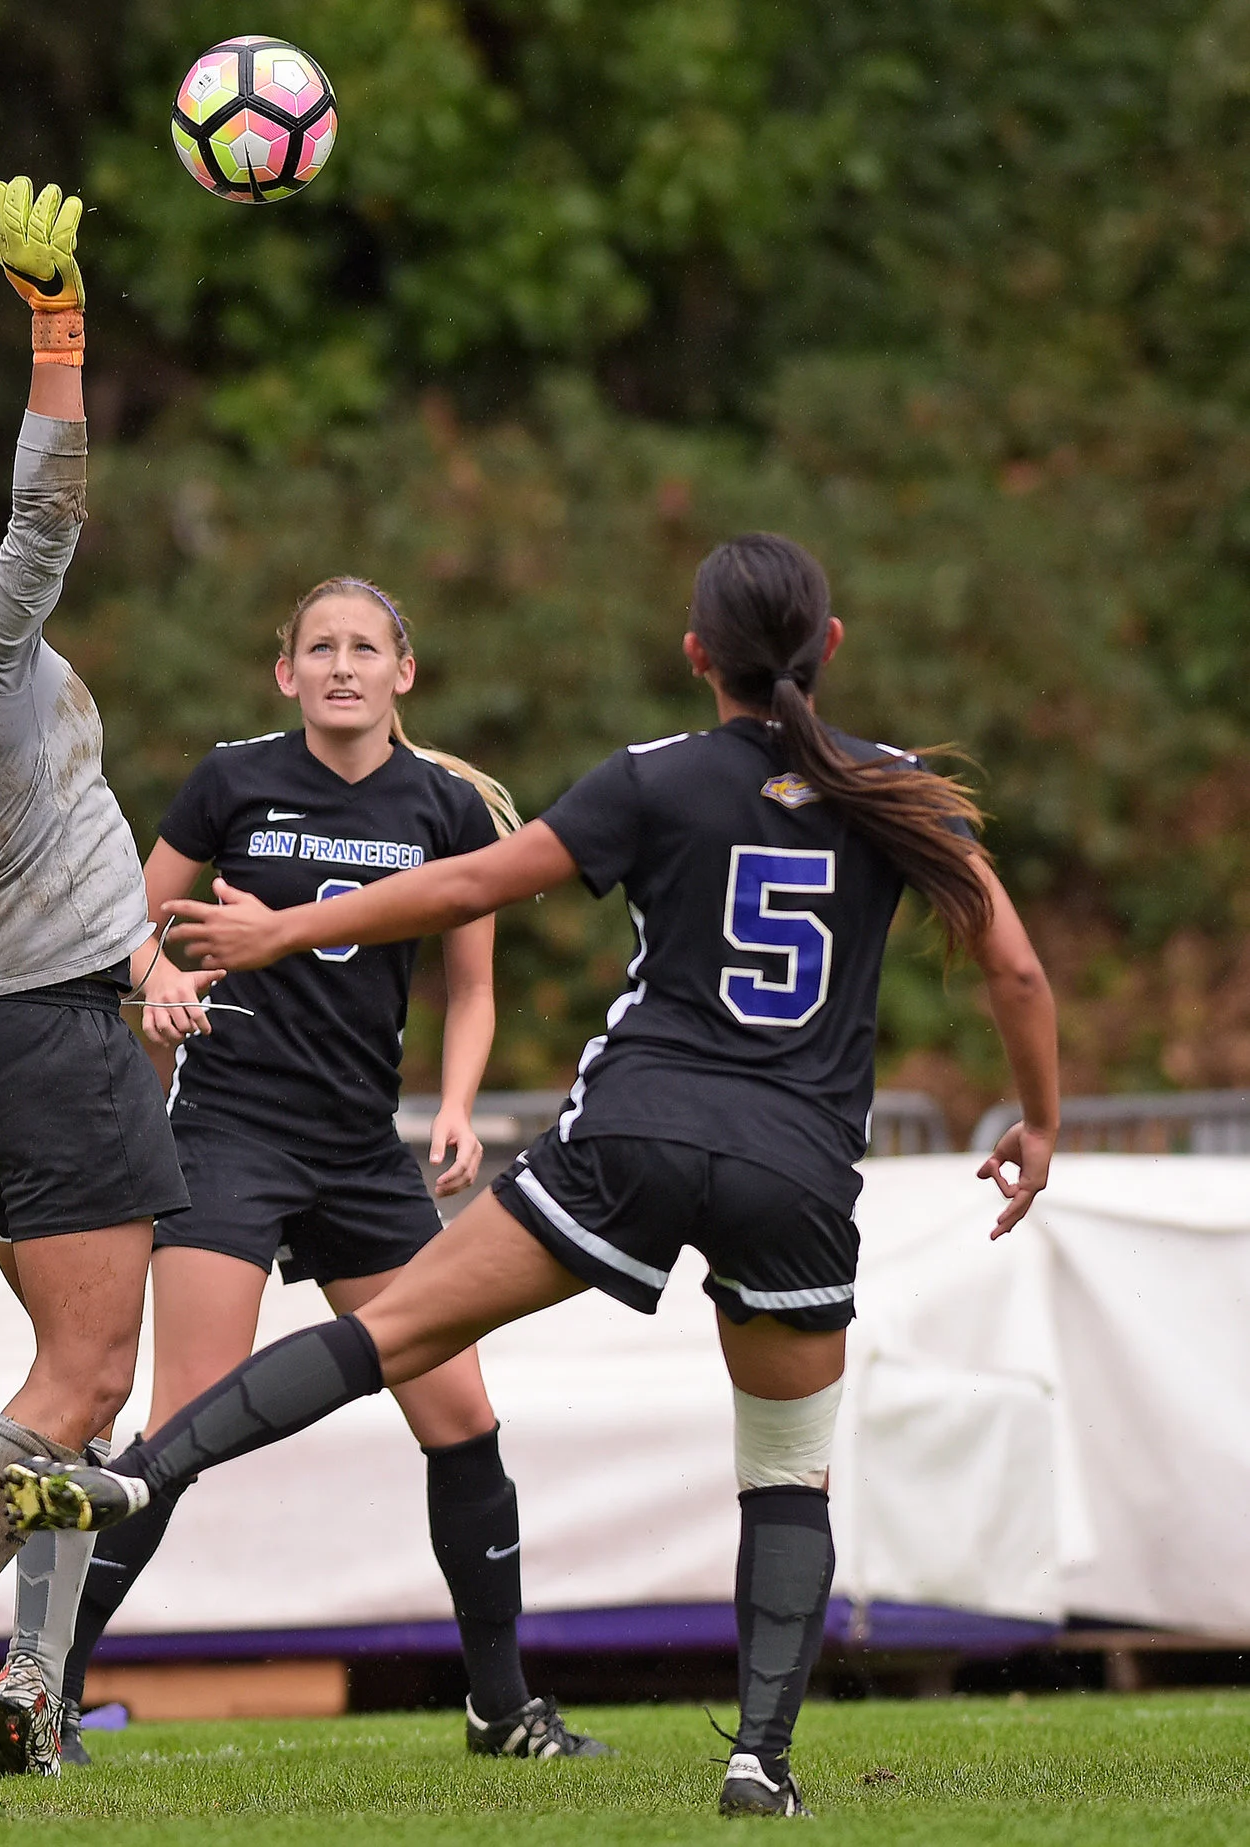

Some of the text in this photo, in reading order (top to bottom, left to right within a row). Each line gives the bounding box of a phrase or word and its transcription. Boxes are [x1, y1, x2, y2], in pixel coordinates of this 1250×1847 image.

[248, 831, 423, 870] SAN FRANCISCO
[719, 845, 835, 1028] 5
